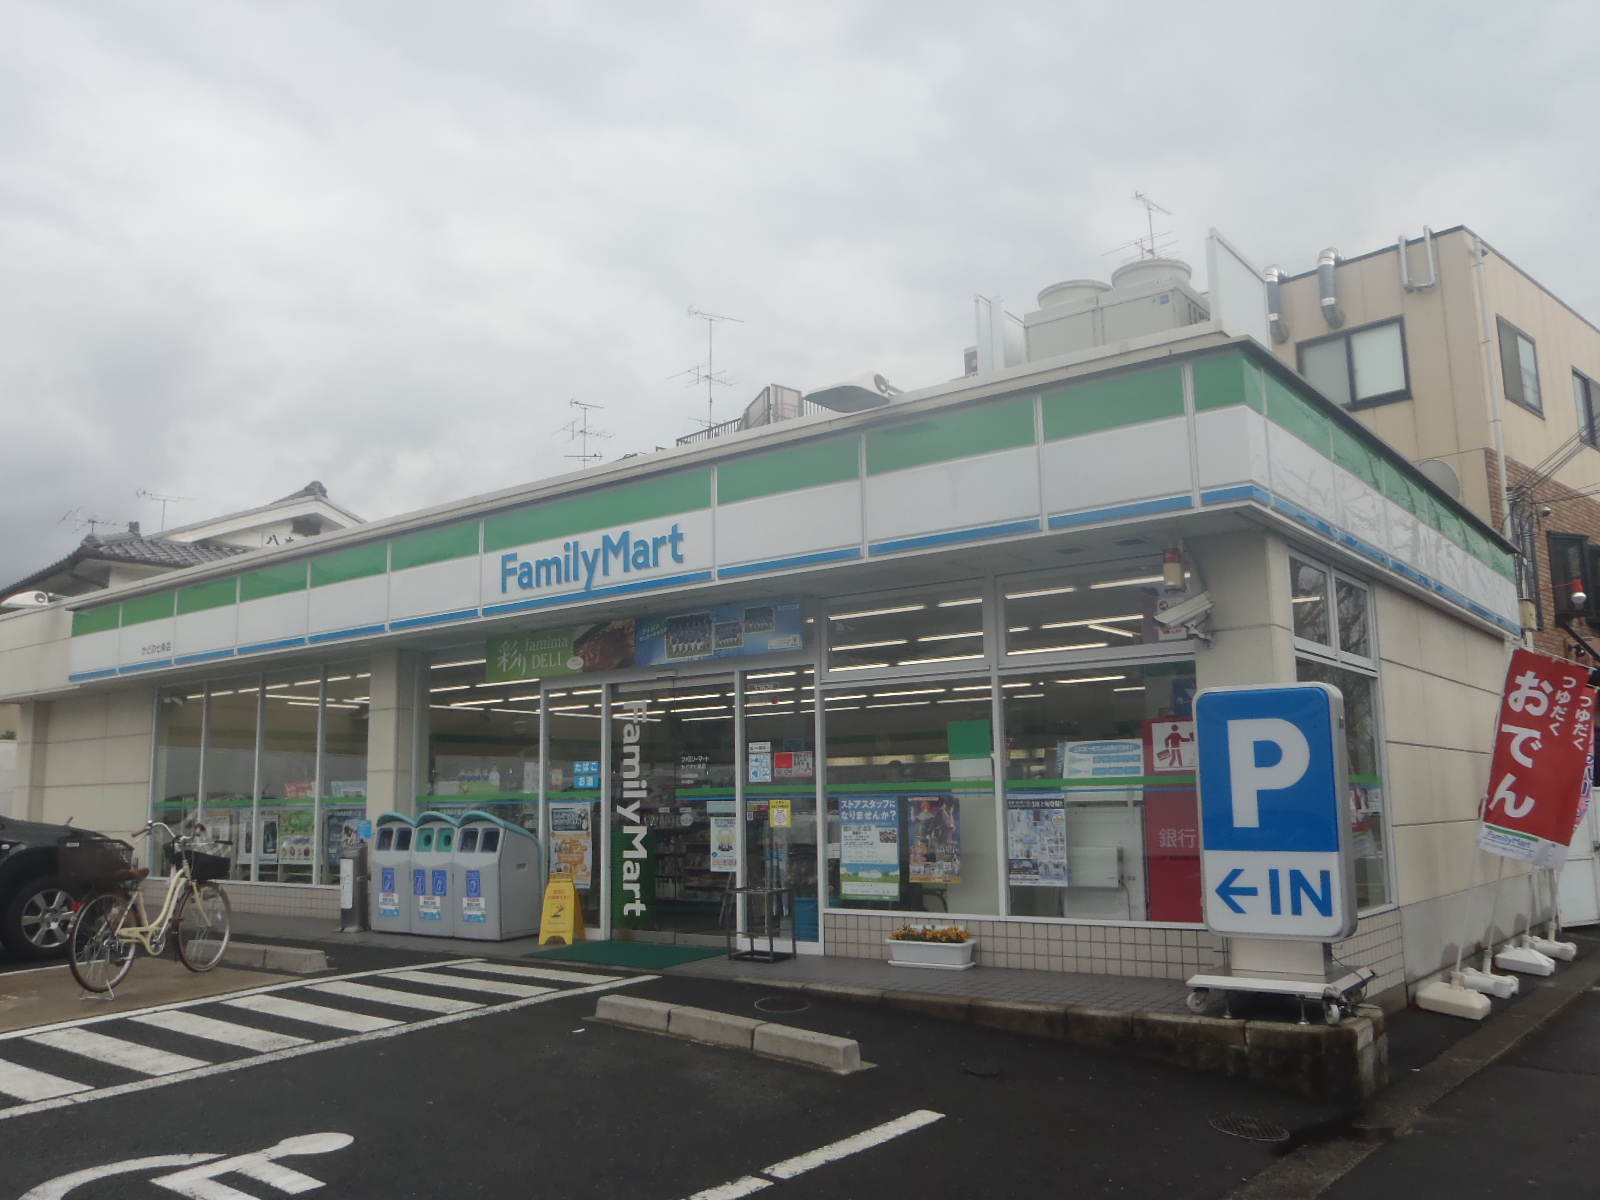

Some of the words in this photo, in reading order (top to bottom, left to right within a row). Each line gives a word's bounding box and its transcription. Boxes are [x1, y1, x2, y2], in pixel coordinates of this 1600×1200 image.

[501, 524, 684, 594] FamilyMart
[525, 636, 569, 653] famima
[532, 653, 562, 670] DELI
[1548, 675, 1577, 737] つゆだく
[1572, 694, 1593, 752] つゆだく
[1226, 717, 1312, 829] P
[1488, 670, 1554, 819] おでん
[616, 700, 648, 918] FamilyMart
[841, 799, 896, 810] ストアスタッフに
[1487, 830, 1533, 850] FamilyMart
[1268, 868, 1333, 917] IN
